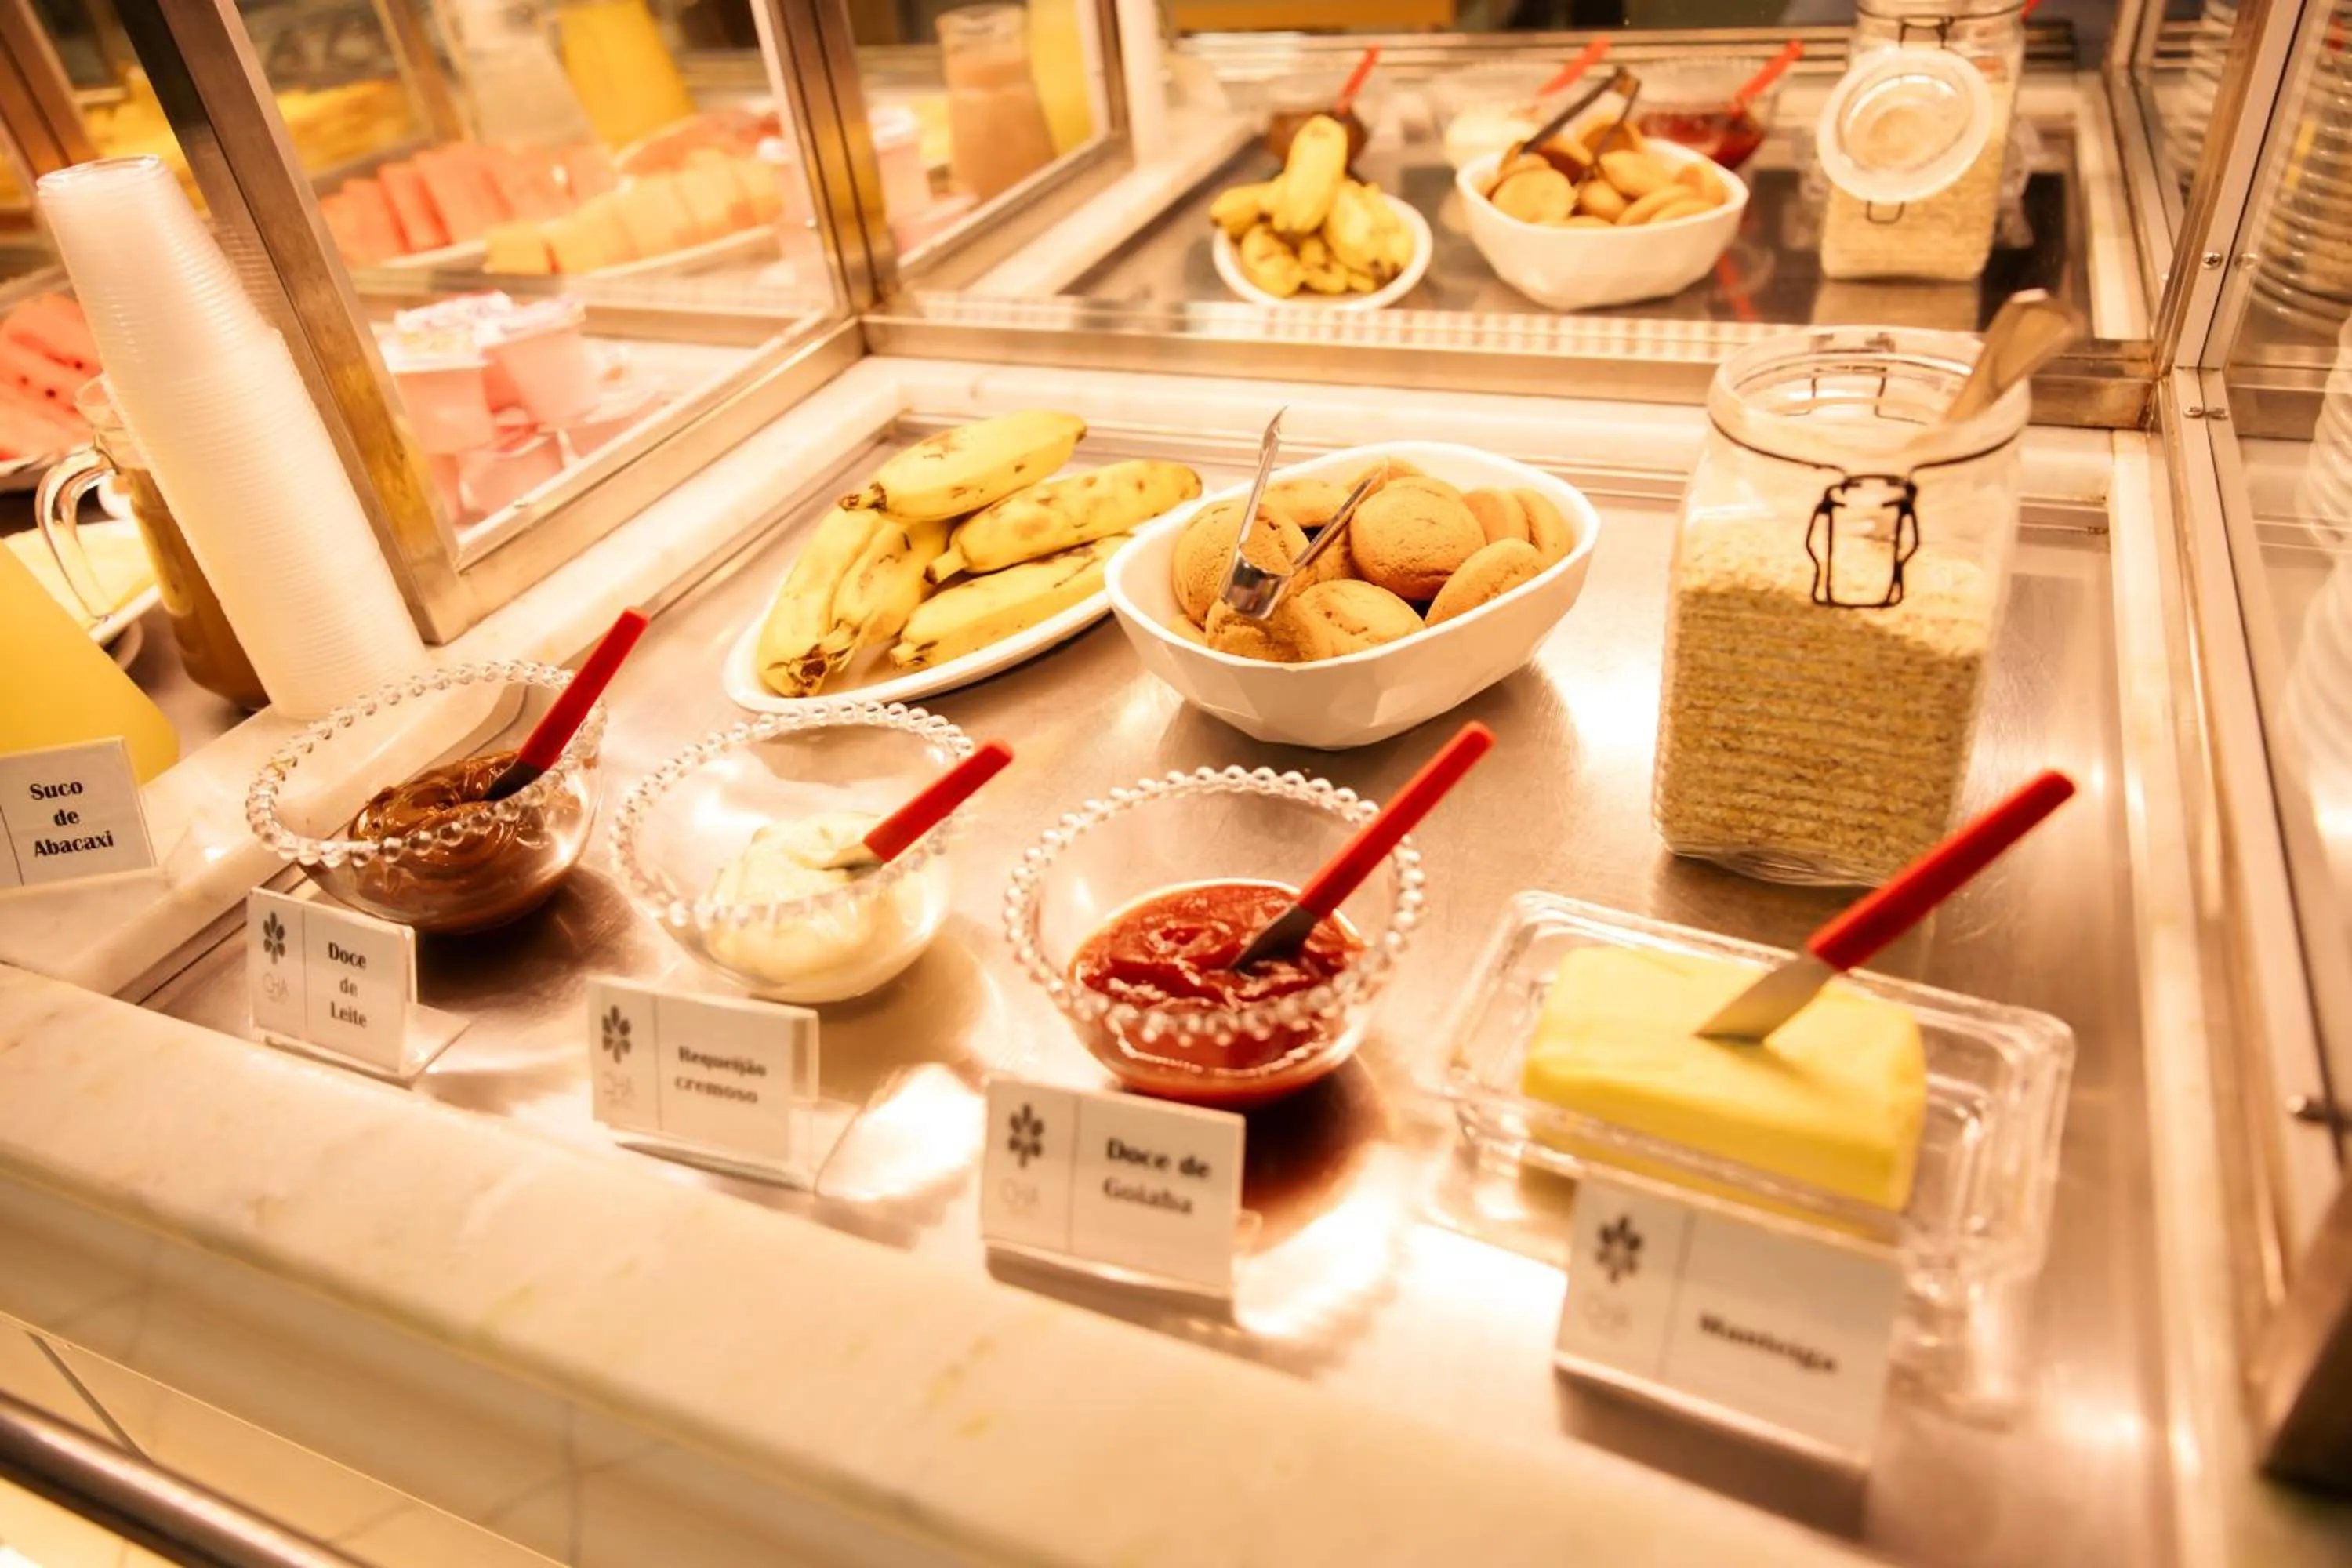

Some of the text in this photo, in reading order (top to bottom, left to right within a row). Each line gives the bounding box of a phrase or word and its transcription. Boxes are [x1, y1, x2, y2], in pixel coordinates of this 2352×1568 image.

[29, 781, 83, 800] Suco
[53, 808, 80, 826] de
[34, 830, 114, 858] Abacaxi
[328, 942, 368, 970] Doce
[339, 977, 359, 997] de
[329, 1000, 368, 1029] Leite
[678, 1045, 768, 1078] Requeijão
[674, 1076, 759, 1105] cremoso
[1105, 1137, 1211, 1178] Doce de
